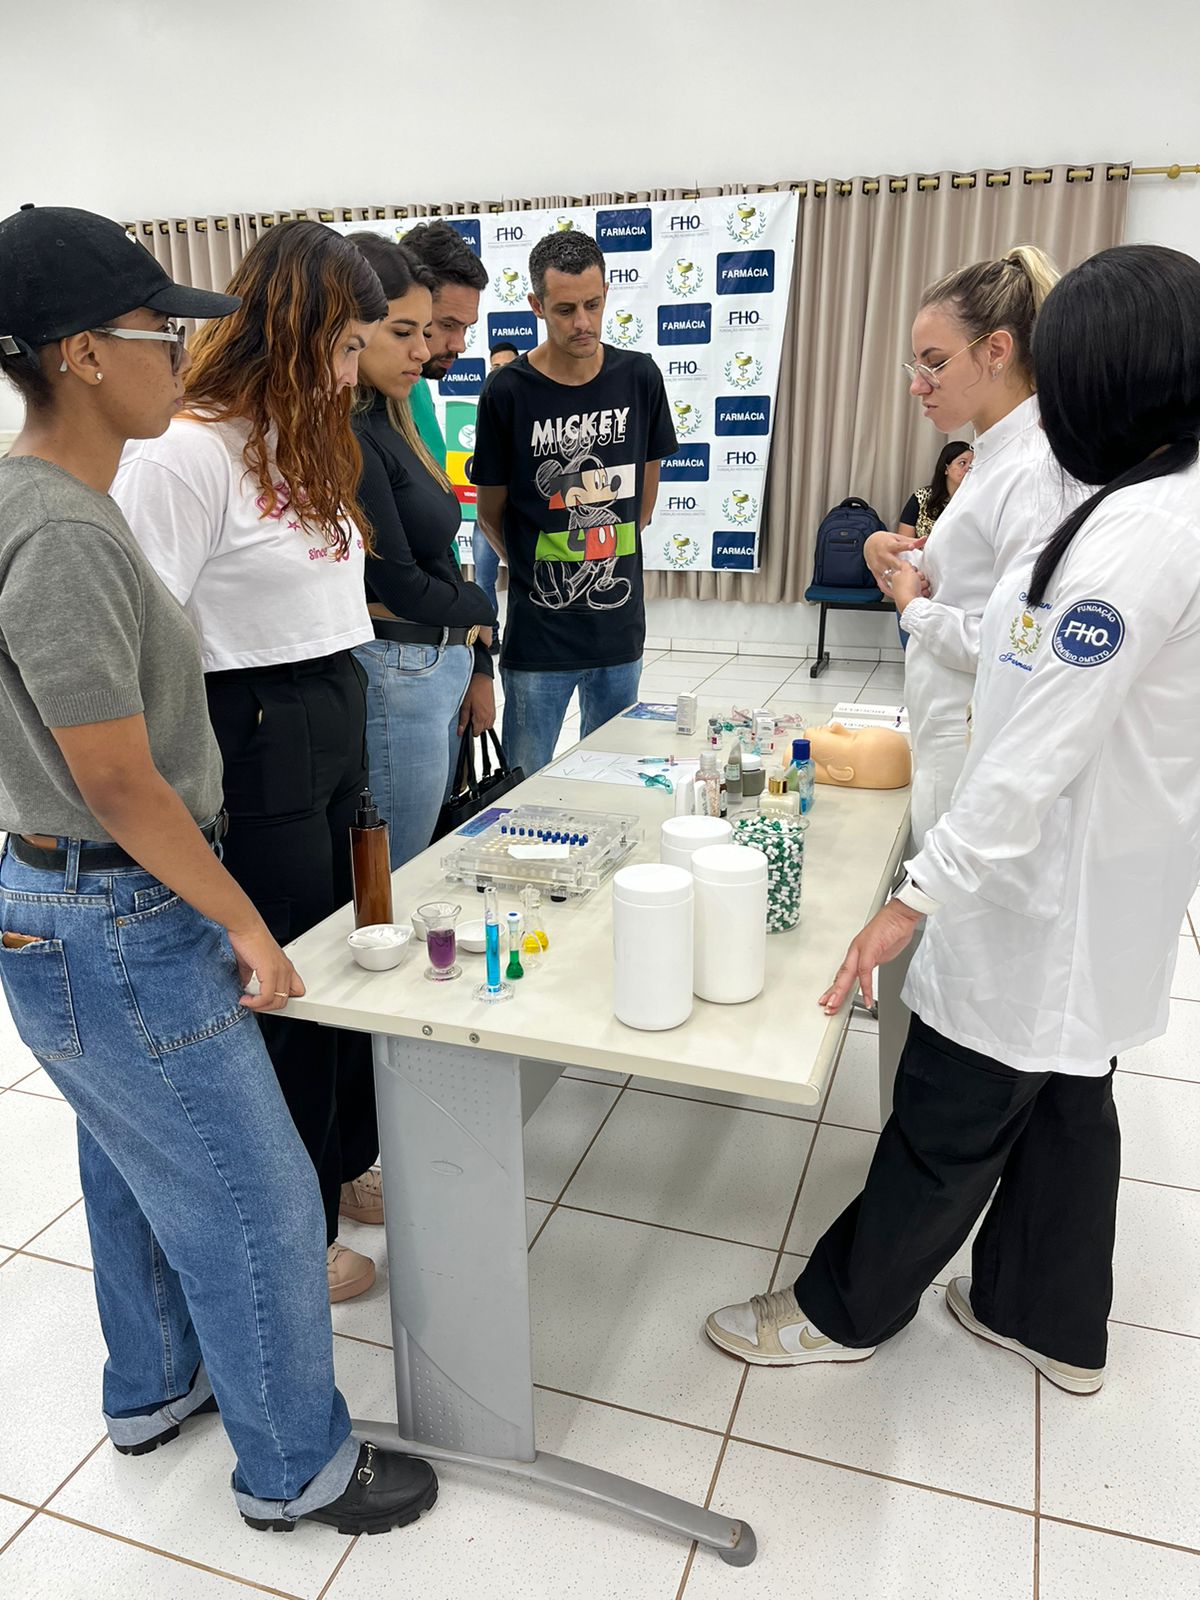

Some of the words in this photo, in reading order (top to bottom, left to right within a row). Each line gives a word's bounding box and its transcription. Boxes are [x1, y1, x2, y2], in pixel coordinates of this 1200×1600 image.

[671, 215, 701, 230] FHO
[496, 226, 523, 241] FHO
[600, 225, 647, 237] FARMÁCIA
[609, 268, 639, 283] FHO
[721, 267, 769, 279] FARMÁCIA
[729, 310, 760, 325] FHO
[492, 326, 533, 336] FARMÁCIA
[662, 319, 706, 330] FARMÁCIA
[669, 360, 697, 374] FHO
[720, 411, 765, 421] FARMÁCIA
[531, 407, 630, 446] MICKEY
[661, 458, 705, 468] FARMÁCIA
[727, 451, 756, 464] FHO
[669, 497, 696, 510] FHO
[458, 535, 473, 547] FH
[1077, 604, 1116, 623] FUNDAÇÃO
[1064, 620, 1109, 647] FHO
[1078, 649, 1110, 662] OMETTO
